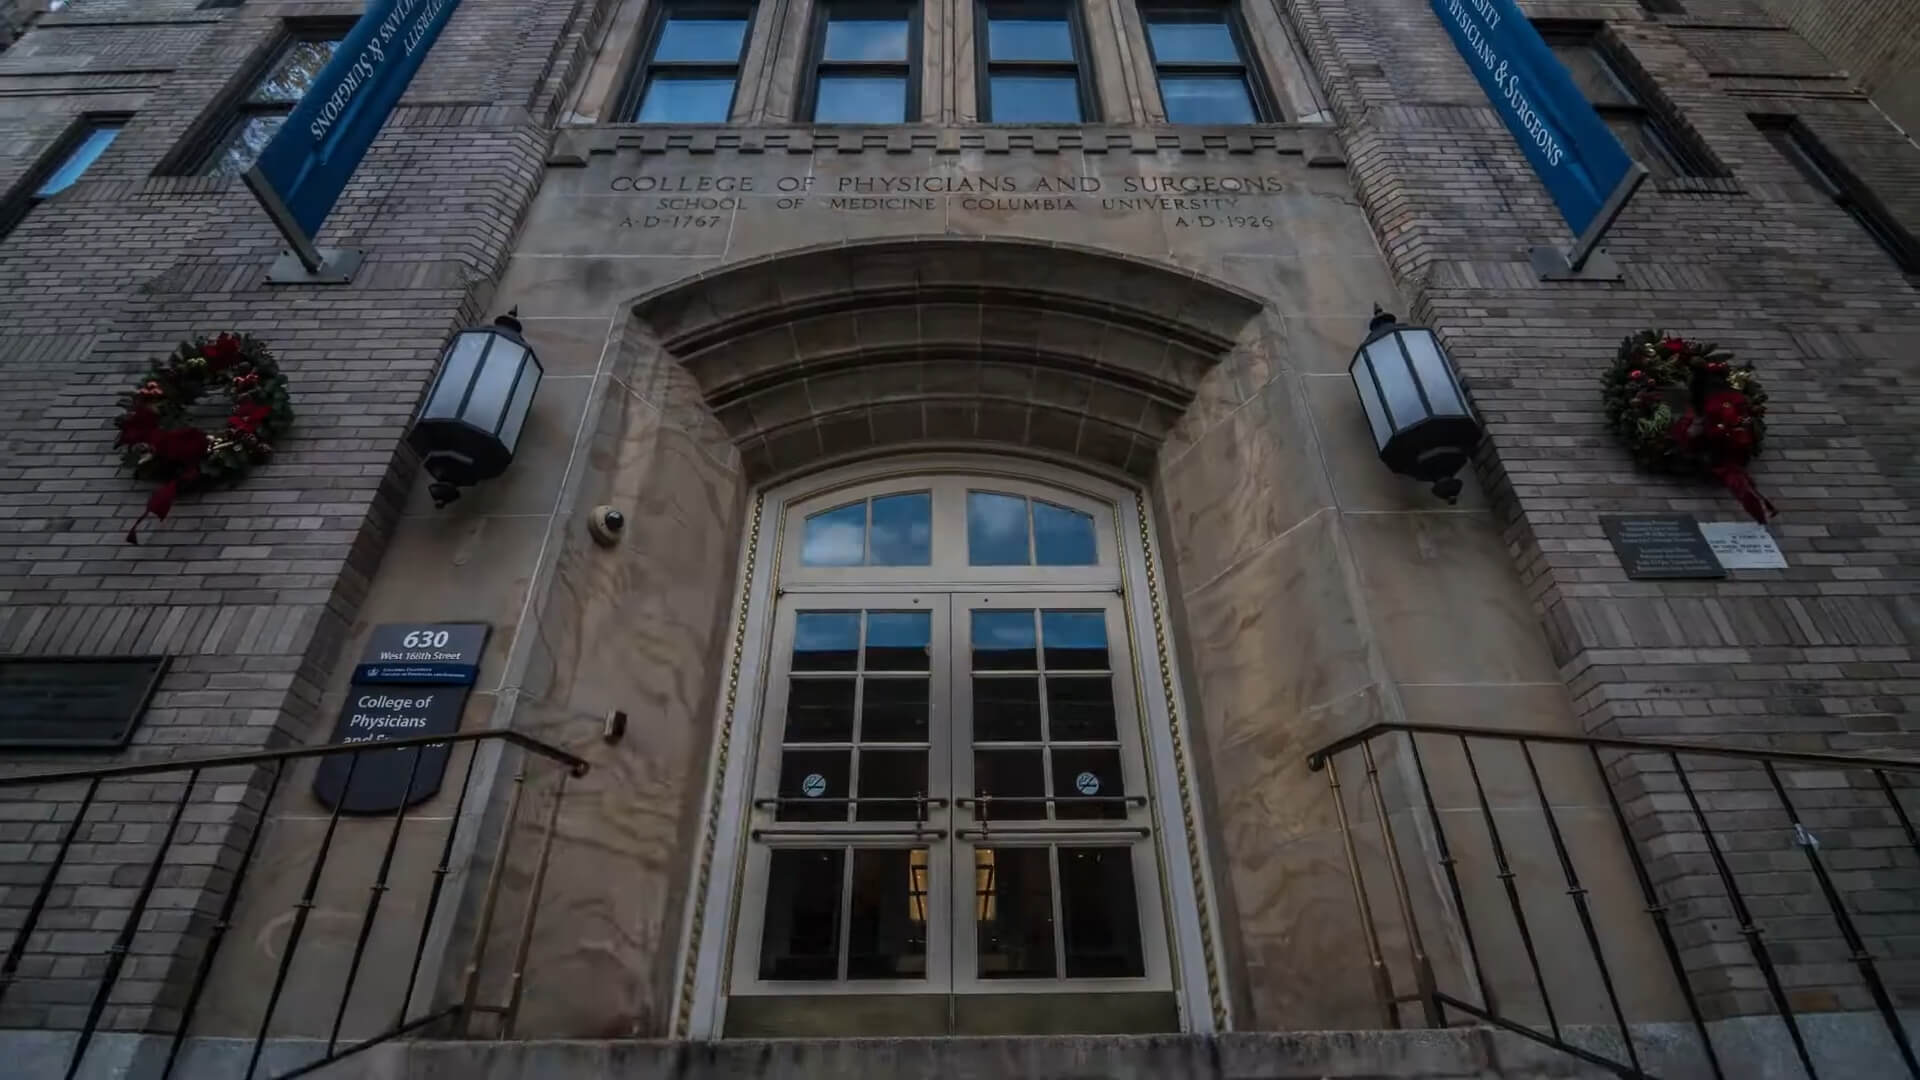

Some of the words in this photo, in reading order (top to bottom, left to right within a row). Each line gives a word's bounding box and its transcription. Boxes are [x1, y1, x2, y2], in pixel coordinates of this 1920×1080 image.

[367, 37, 385, 62] &
[310, 53, 374, 141] SURGEONS
[1494, 60, 1508, 88] &
[1504, 75, 1563, 167] SURGEONS
[610, 176, 753, 192] COLLEGE
[776, 176, 816, 192] OF
[838, 176, 1017, 192] PHYSICIANS
[1035, 176, 1101, 192] AND
[1124, 176, 1283, 192] SURGEONS
[656, 198, 748, 210] SCHOOL
[776, 198, 804, 210] OF
[830, 198, 936, 210] MEDICINE
[962, 199, 1078, 211] COLUMBIA
[1102, 198, 1239, 210] UNIVERSITY
[404, 631, 448, 648] 630
[380, 651, 403, 660] West
[433, 651, 462, 660] Street
[358, 695, 412, 711] College
[416, 695, 433, 708] of
[350, 714, 427, 730] Physicians
